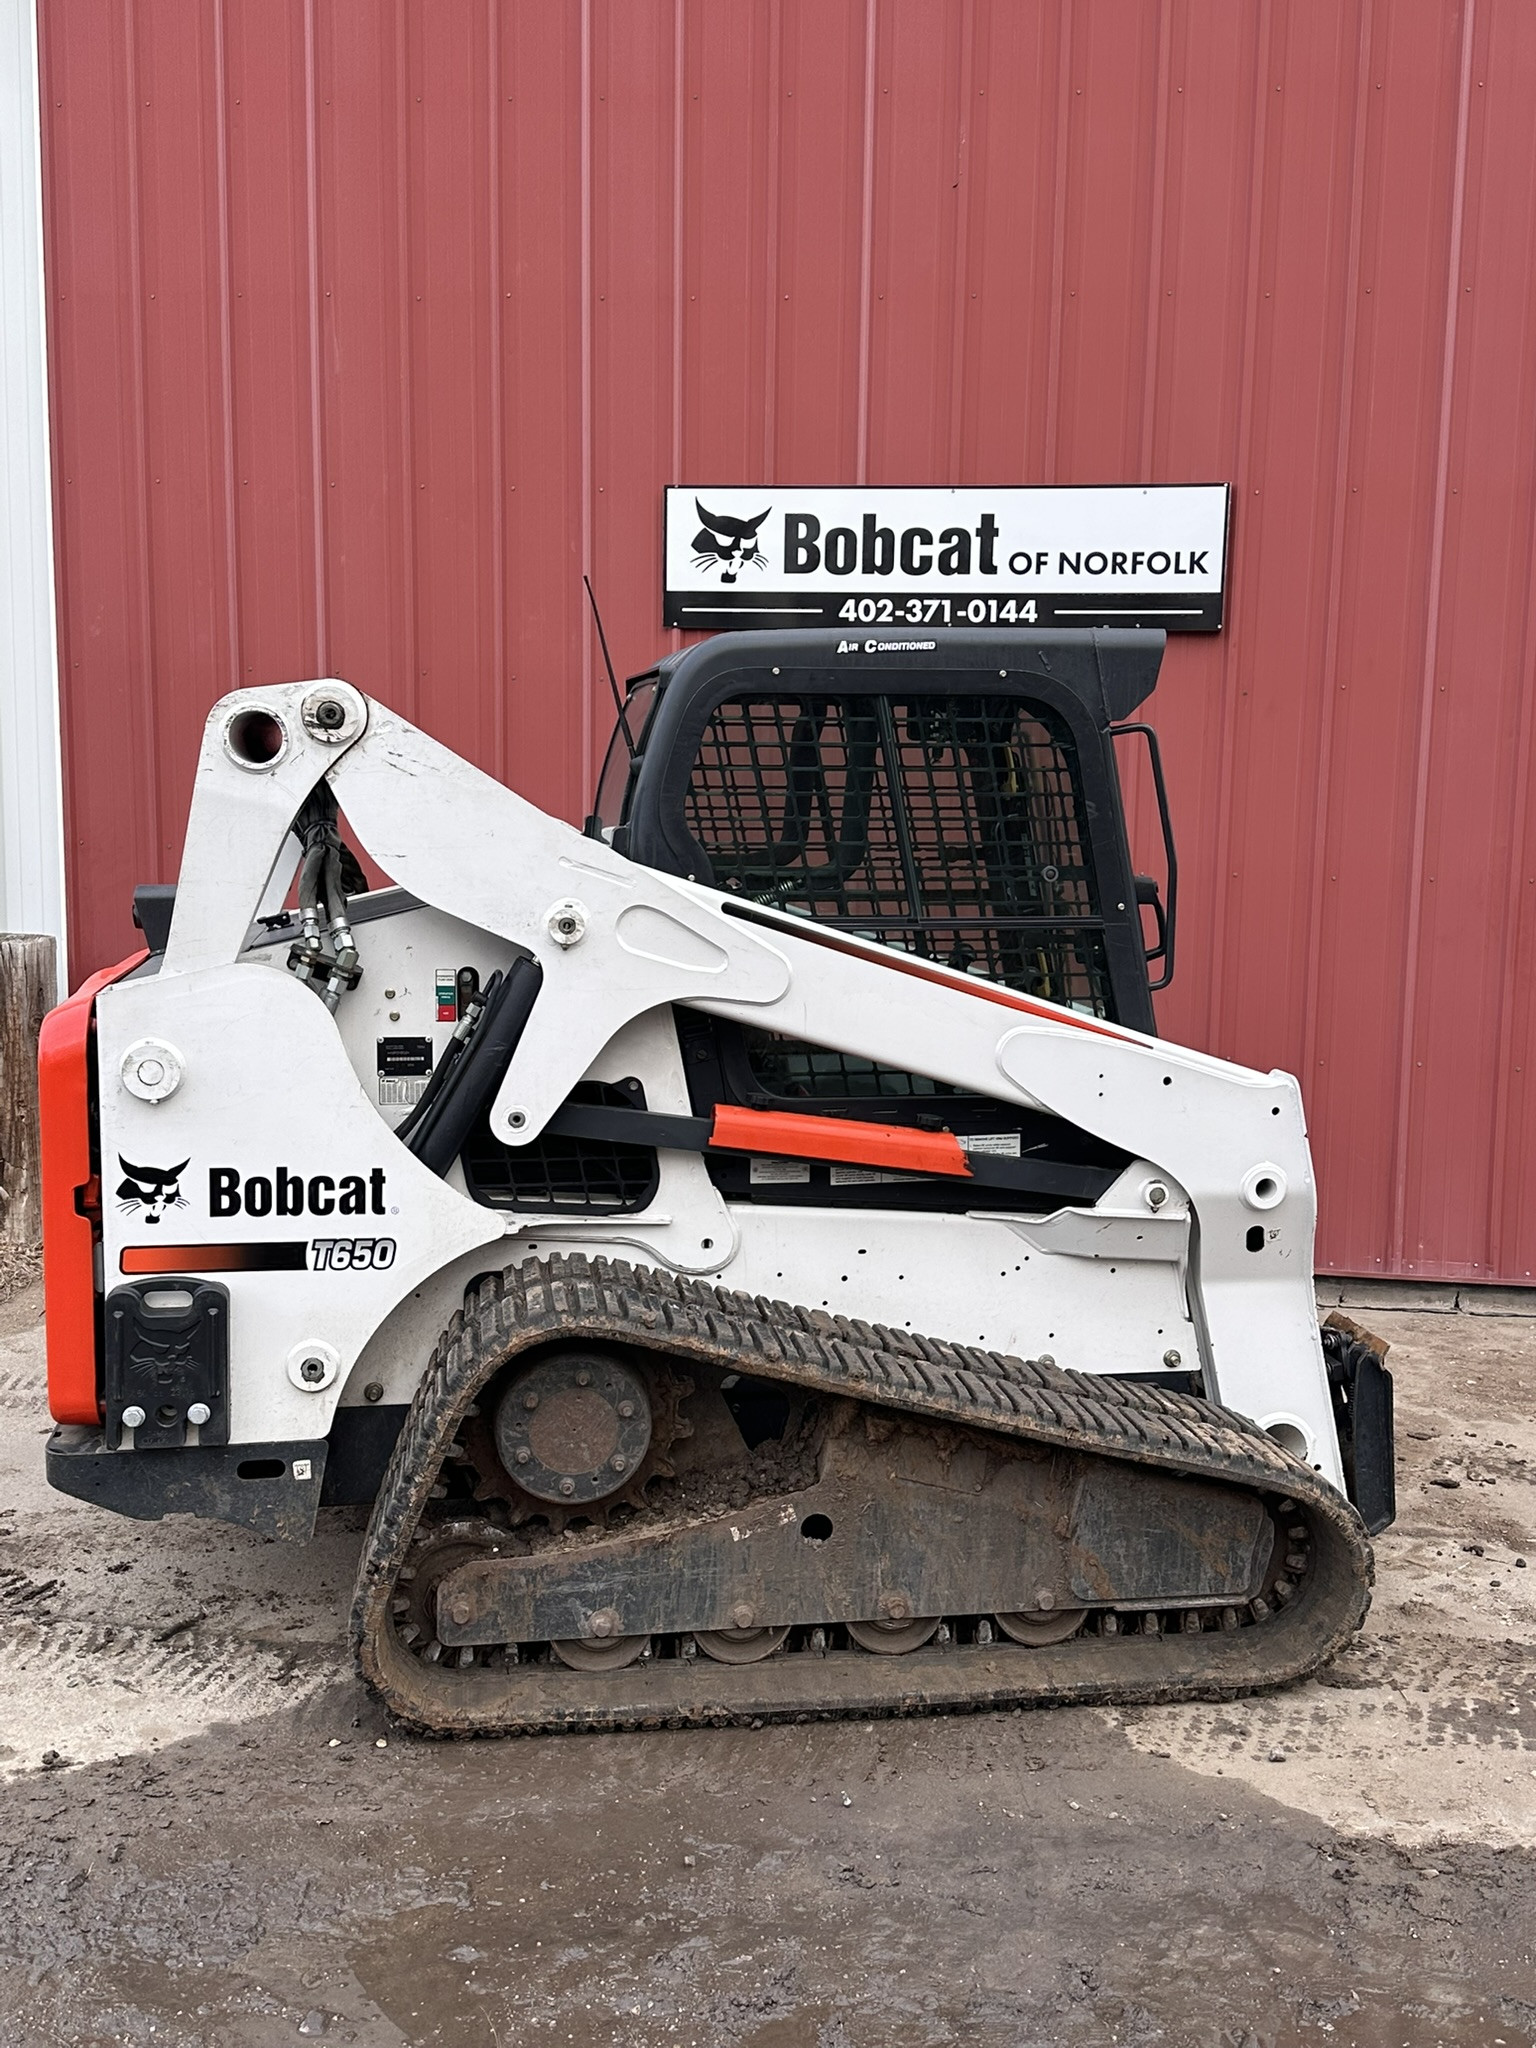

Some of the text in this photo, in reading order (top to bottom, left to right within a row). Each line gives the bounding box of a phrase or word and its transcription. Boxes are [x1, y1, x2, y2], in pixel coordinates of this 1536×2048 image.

[784, 513, 1208, 575] Bobcat OF NORFOLK
[838, 598, 1038, 624] 402-371-0144
[209, 1166, 386, 1218] Bobcat
[311, 1238, 397, 1272] T650
